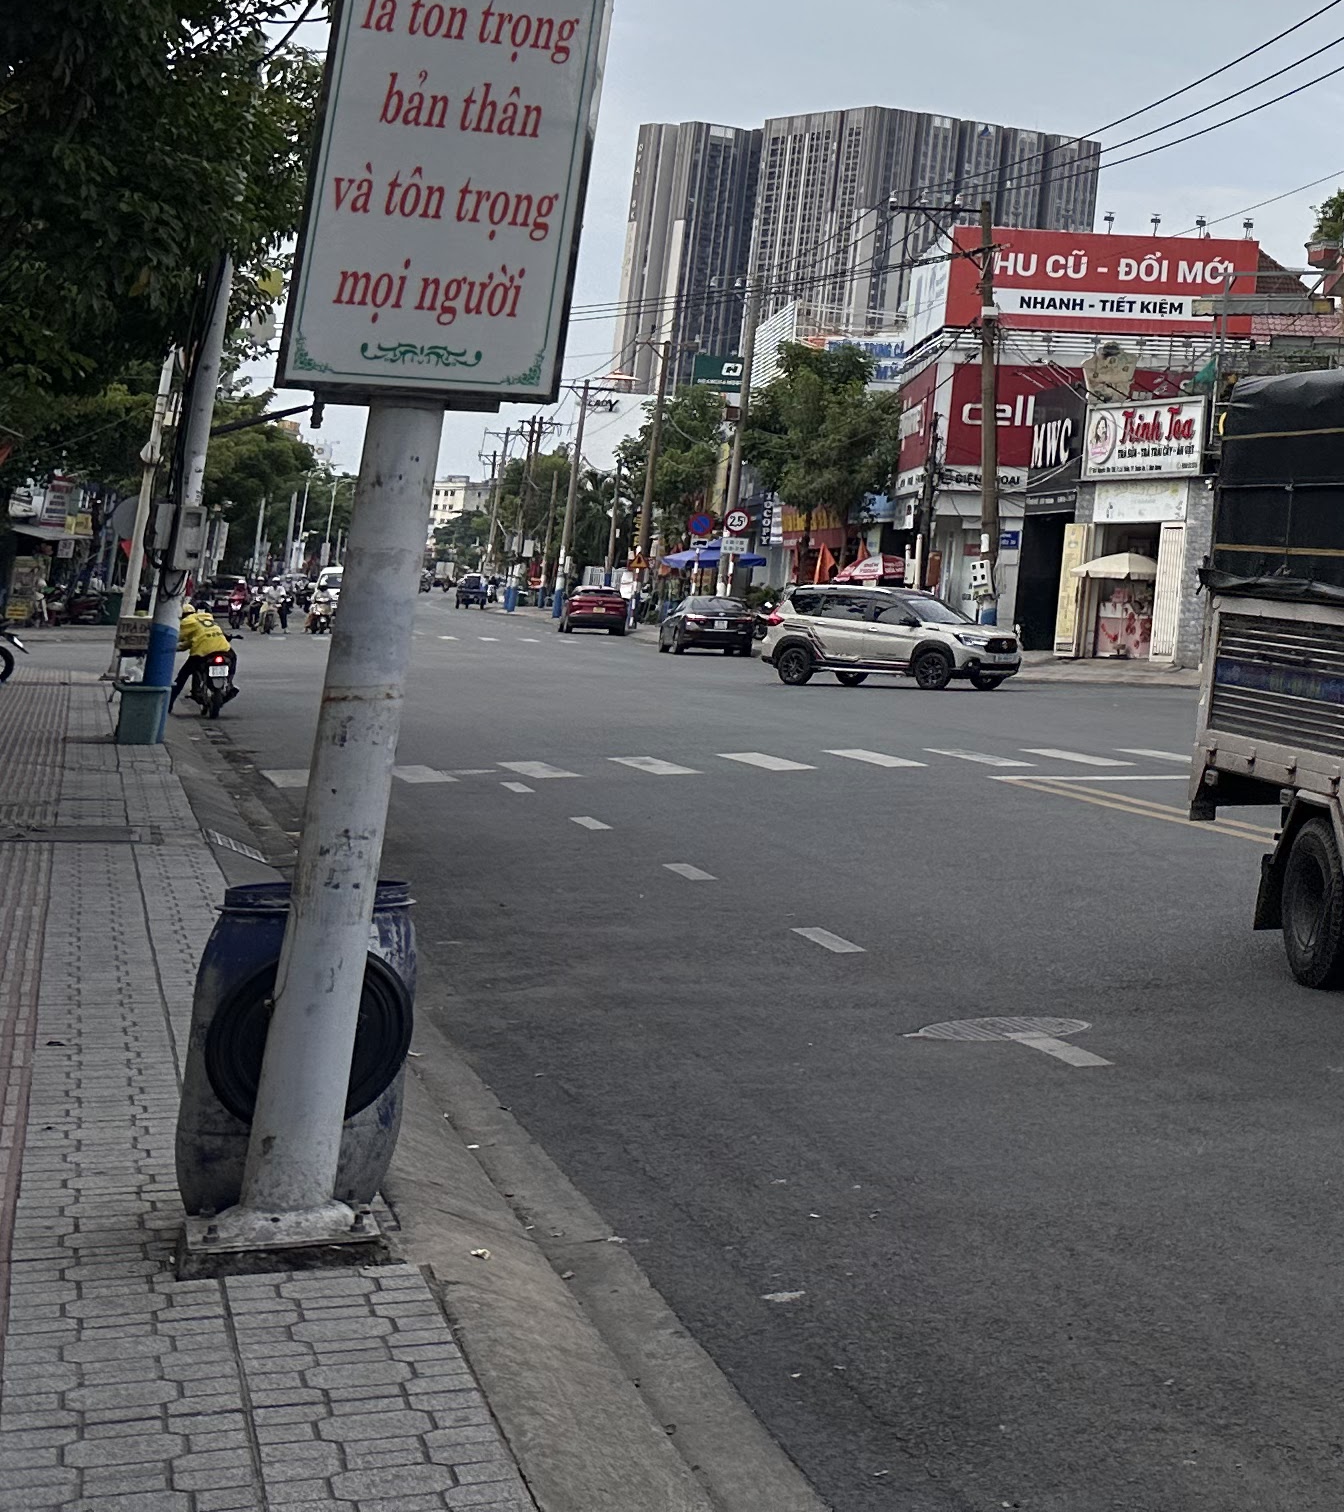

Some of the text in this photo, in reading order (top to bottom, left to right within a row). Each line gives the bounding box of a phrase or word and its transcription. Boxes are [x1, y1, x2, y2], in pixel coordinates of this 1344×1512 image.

[478, 0, 581, 65] trọng
[379, 69, 543, 139] bản thân
[333, 161, 374, 215] và
[385, 166, 446, 220] tôn
[456, 177, 560, 242] trọng
[332, 257, 526, 326] mọi người
[1045, 249, 1089, 280] CŨ
[1118, 251, 1169, 283] ĐỔI
[1177, 256, 1235, 285] MỚI
[1019, 295, 1085, 311] NHANH
[1100, 296, 1137, 313] TIẾT
[1140, 299, 1183, 317] KIỆM
[1030, 417, 1072, 469] MWC
